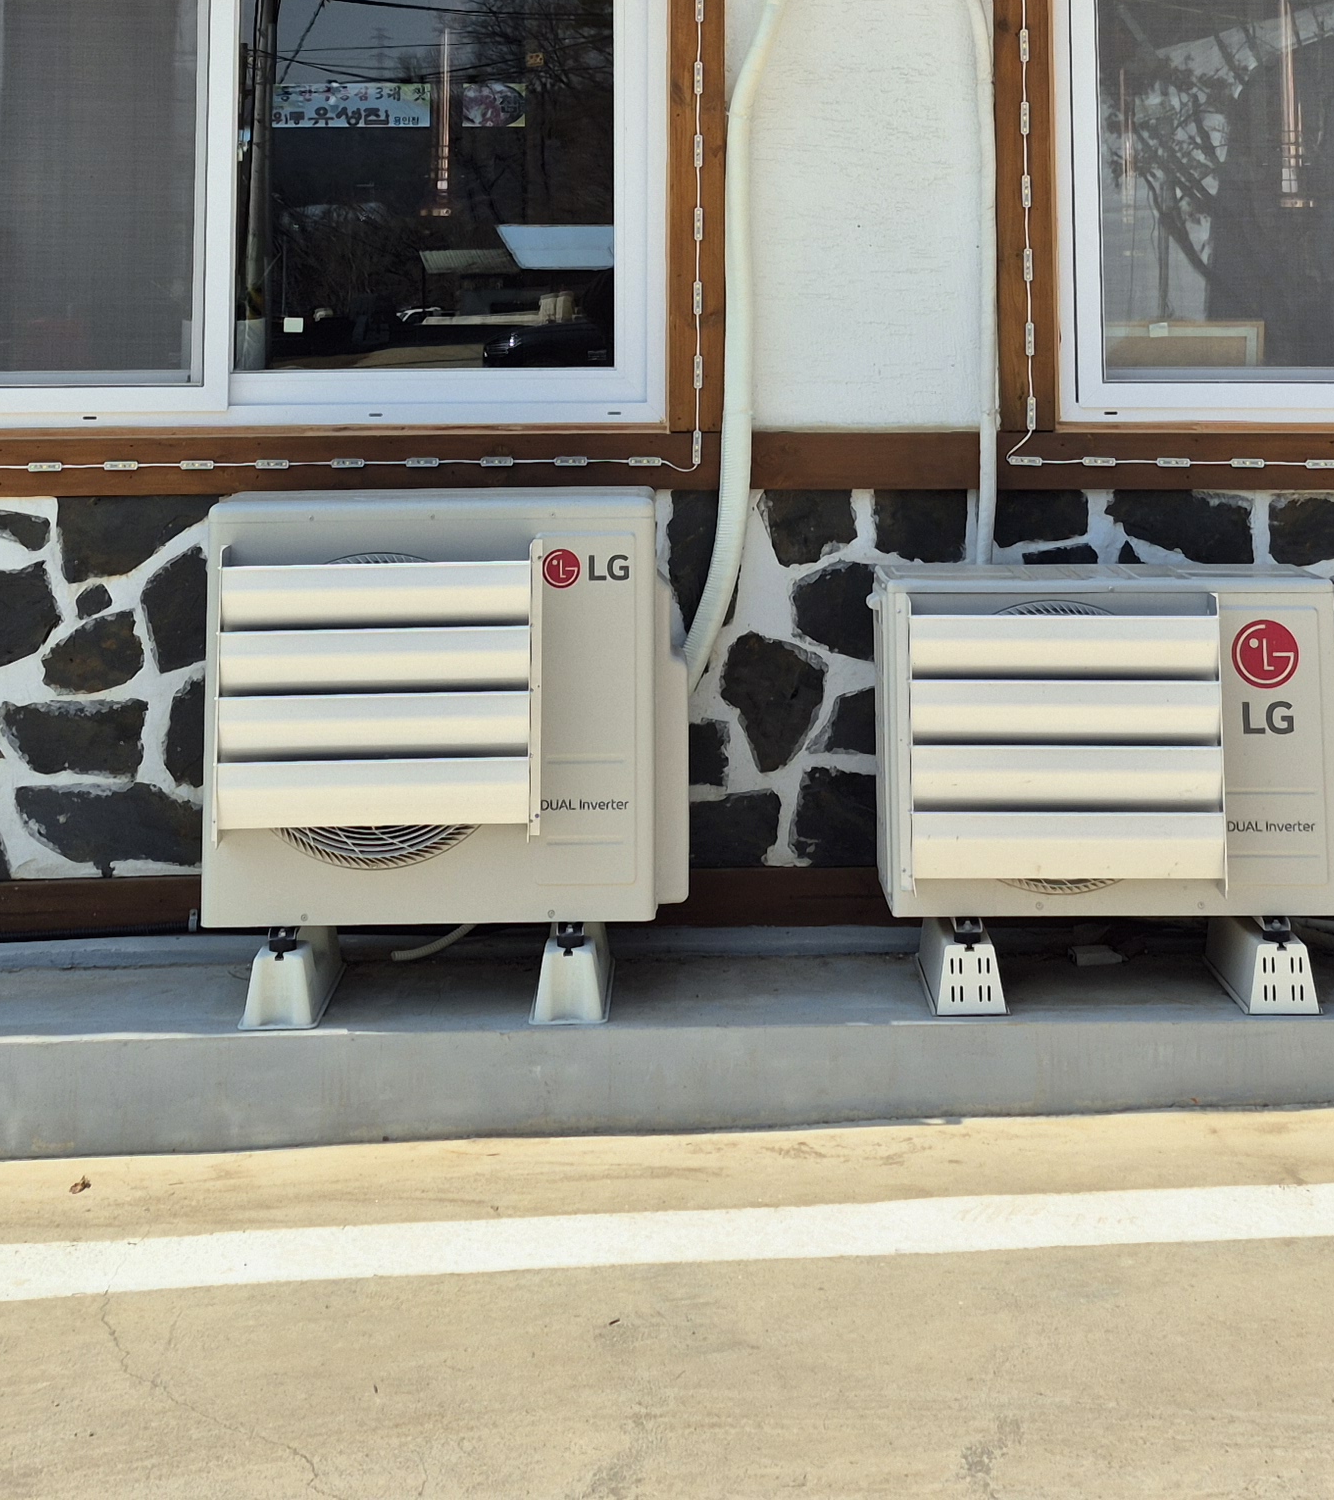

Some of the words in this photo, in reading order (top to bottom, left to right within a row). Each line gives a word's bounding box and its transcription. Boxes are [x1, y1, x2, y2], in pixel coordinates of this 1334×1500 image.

[308, 106, 390, 127] 유성집
[588, 554, 631, 582] LG
[1241, 700, 1296, 736] LG
[540, 798, 577, 811] DUAL
[579, 798, 630, 811] Inverter
[1227, 820, 1264, 833] DUAL
[1265, 820, 1316, 833] Inverter
